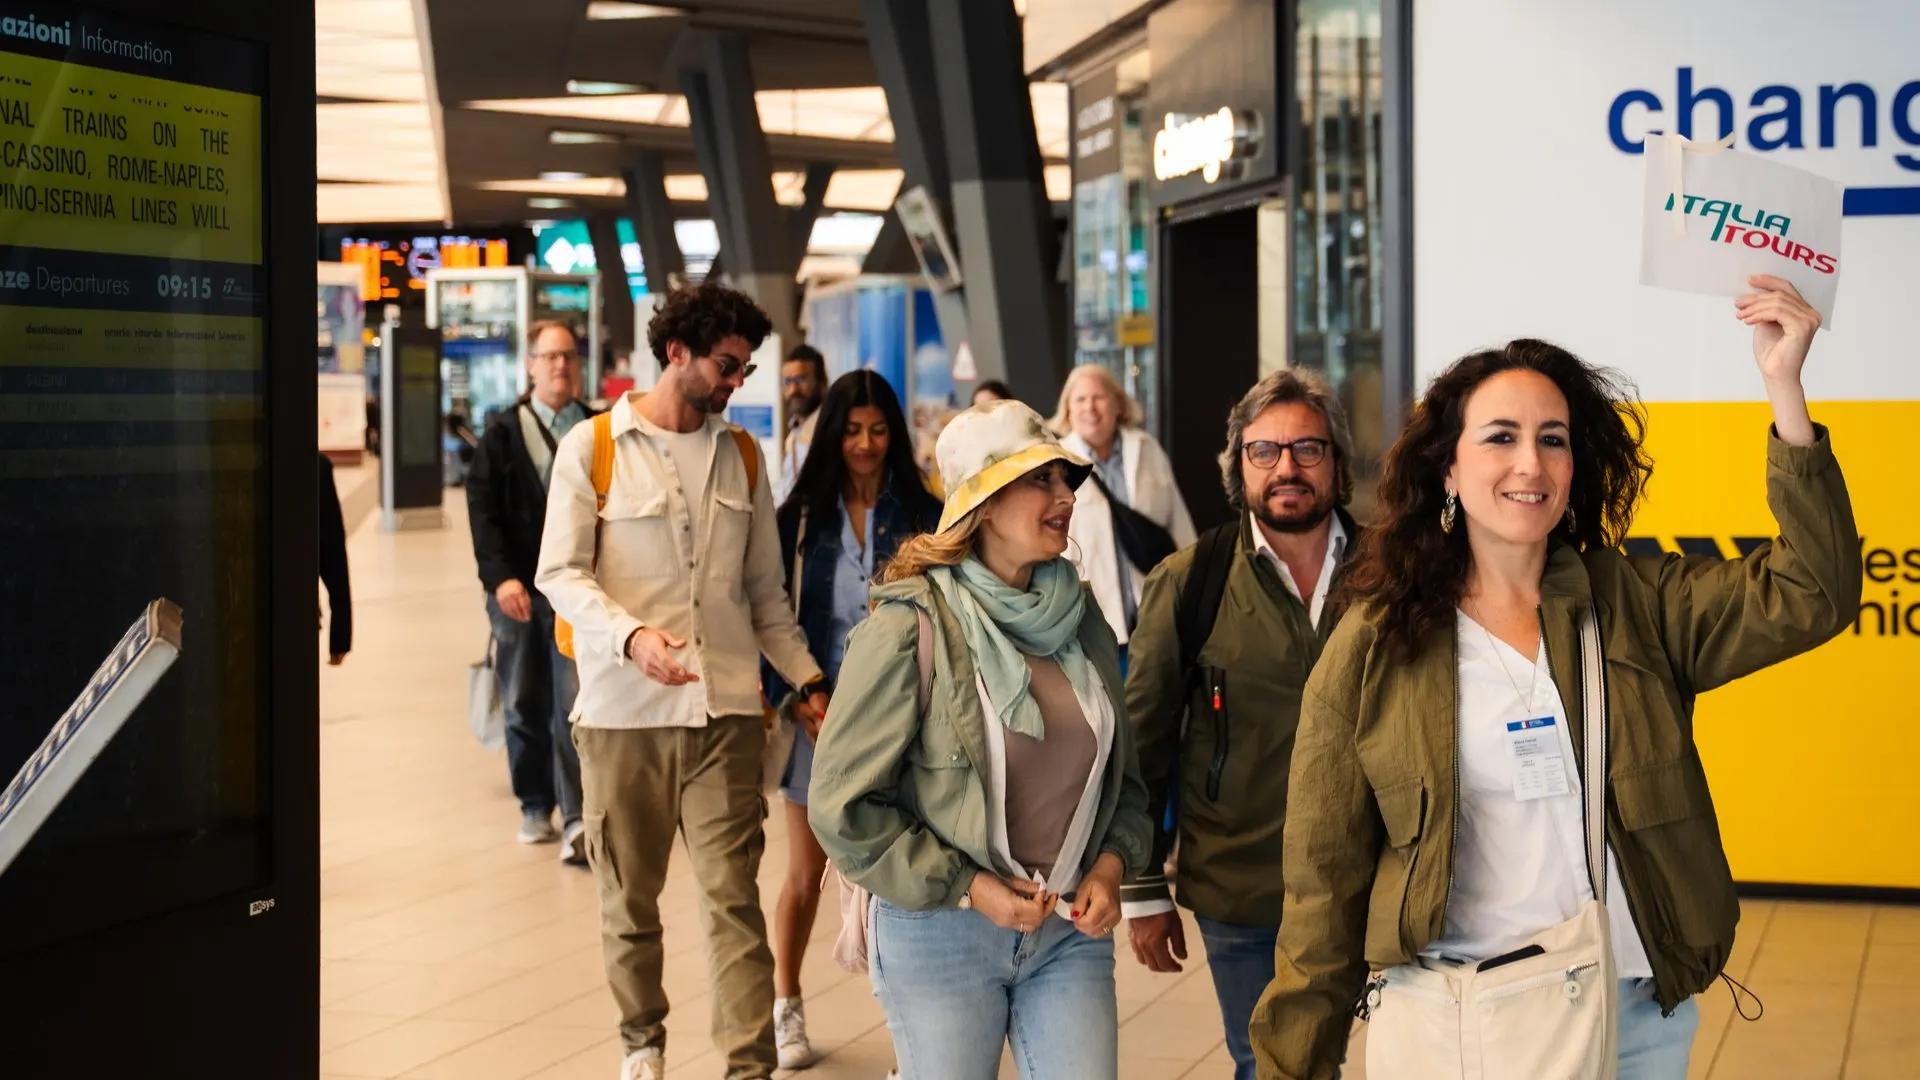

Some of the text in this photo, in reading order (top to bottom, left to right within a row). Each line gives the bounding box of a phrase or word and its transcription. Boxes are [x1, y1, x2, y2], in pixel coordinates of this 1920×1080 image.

[0, 14, 172, 65] azioni Information
[62, 107, 127, 141] TRAINS
[153, 121, 177, 148] ON
[200, 128, 229, 155] THE
[108, 154, 229, 196] ROME-NAPLES,
[131, 196, 177, 226] LINES
[192, 202, 230, 230] WILL
[1665, 192, 1791, 241] ITALIA
[1724, 225, 1837, 274] TOURS
[36, 266, 130, 297] Departures
[157, 273, 213, 300] 09:15
